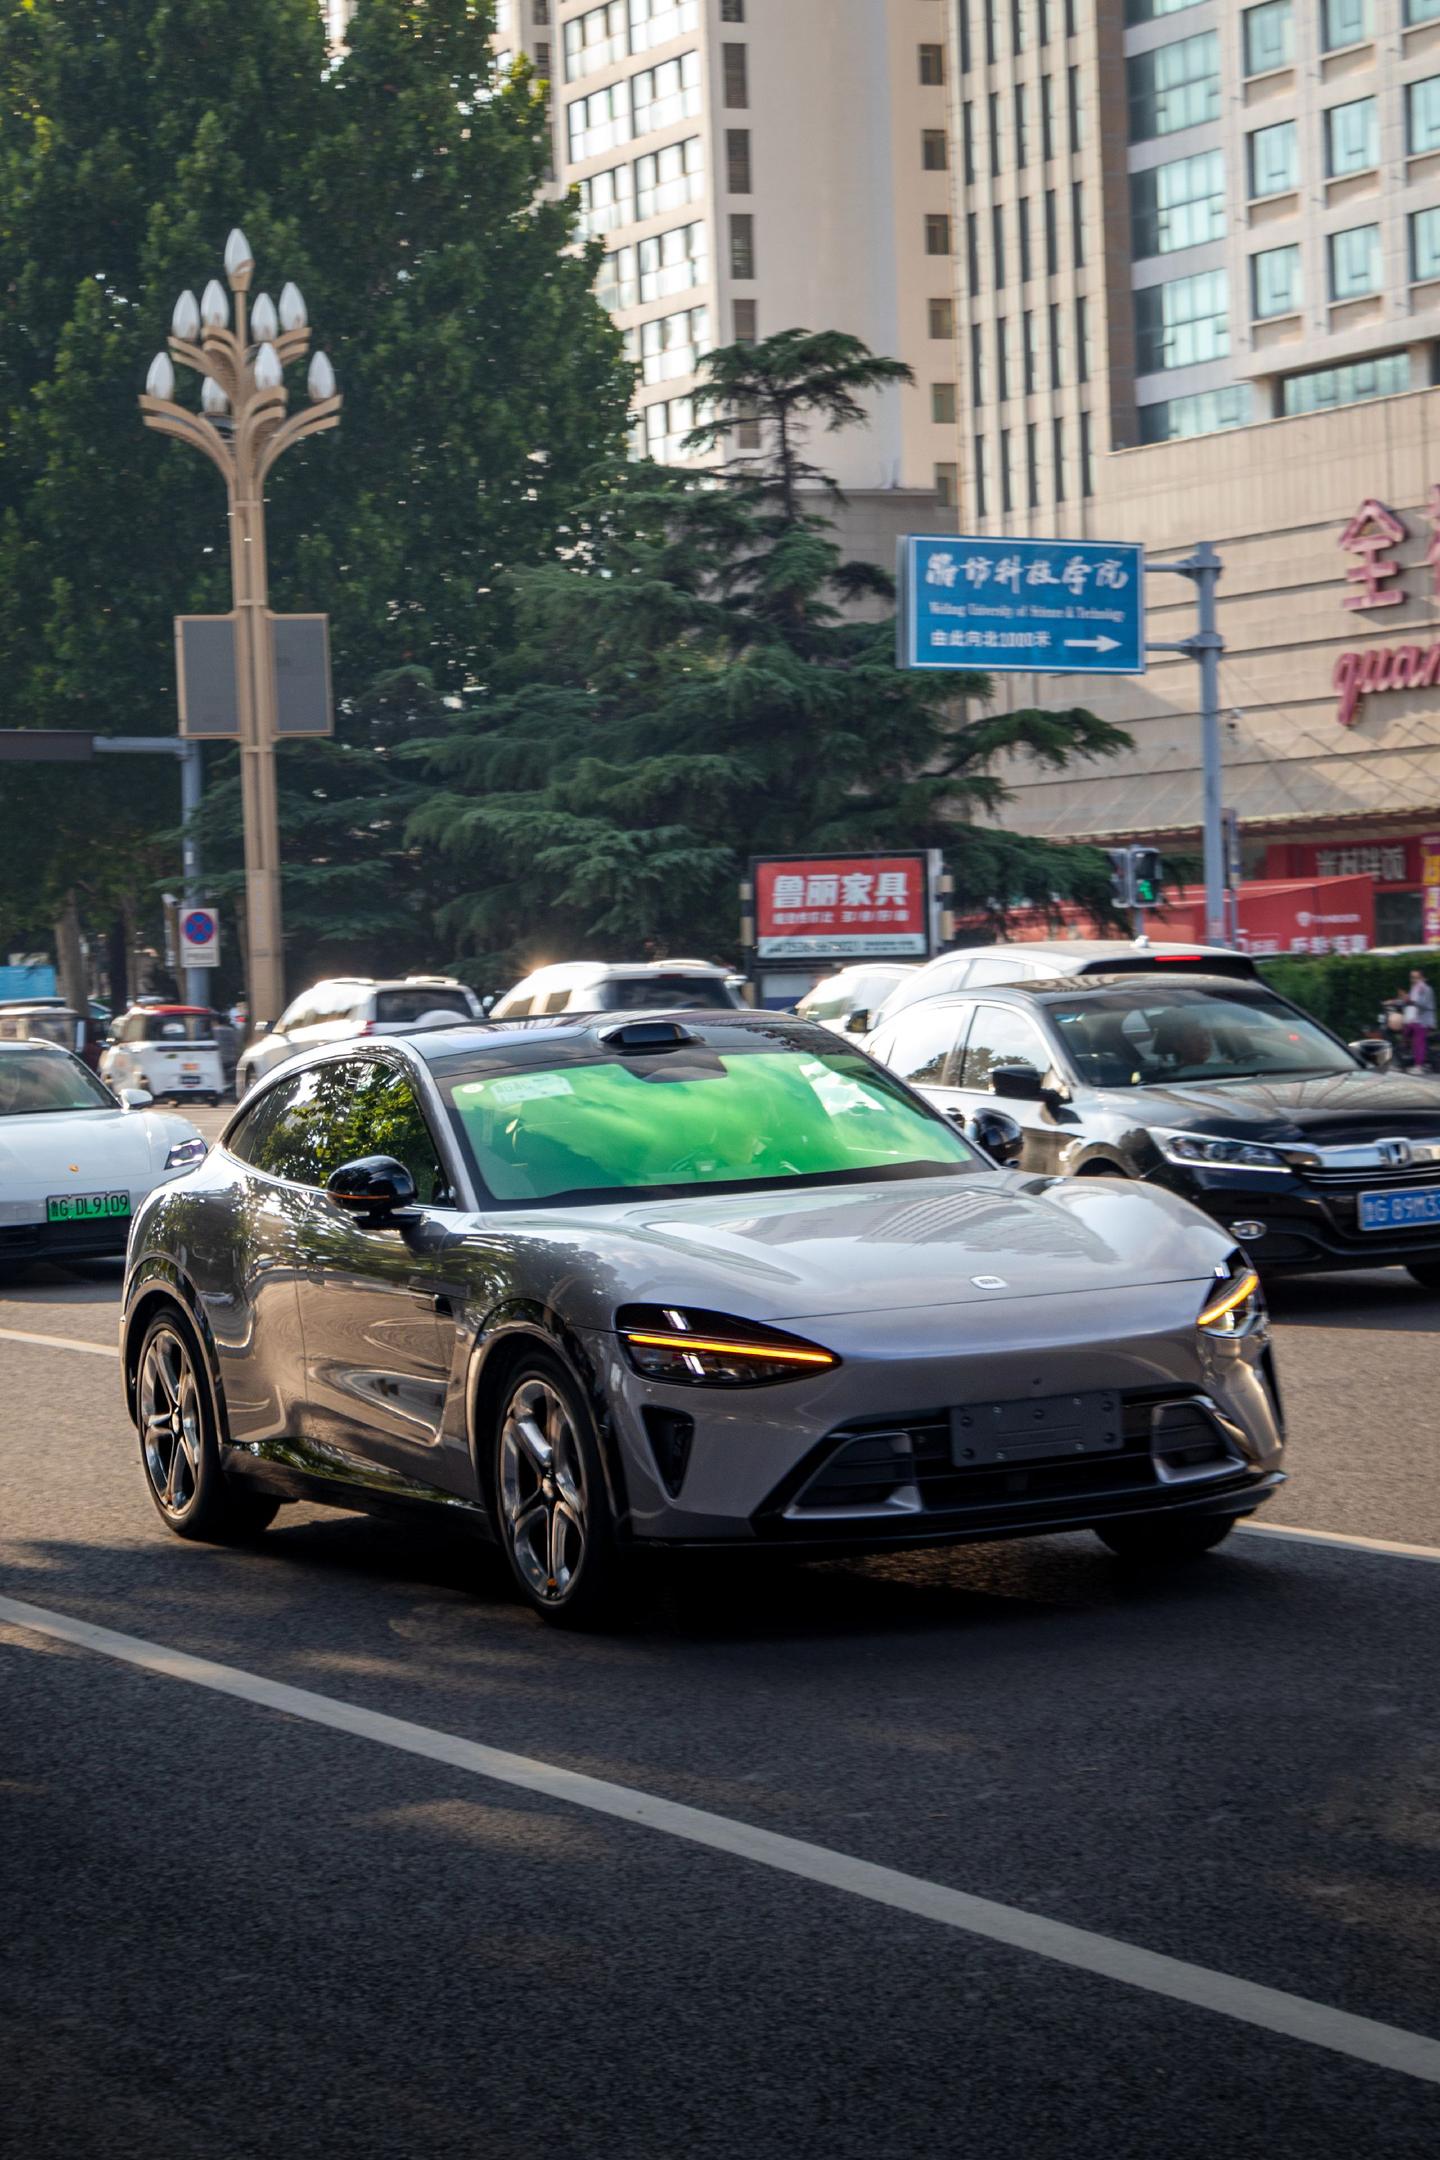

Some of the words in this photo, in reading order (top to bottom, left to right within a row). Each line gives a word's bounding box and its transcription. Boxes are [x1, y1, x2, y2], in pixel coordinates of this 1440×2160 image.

[1338, 484, 1440, 612] 全
[772, 872, 910, 909] 鲁丽家具
